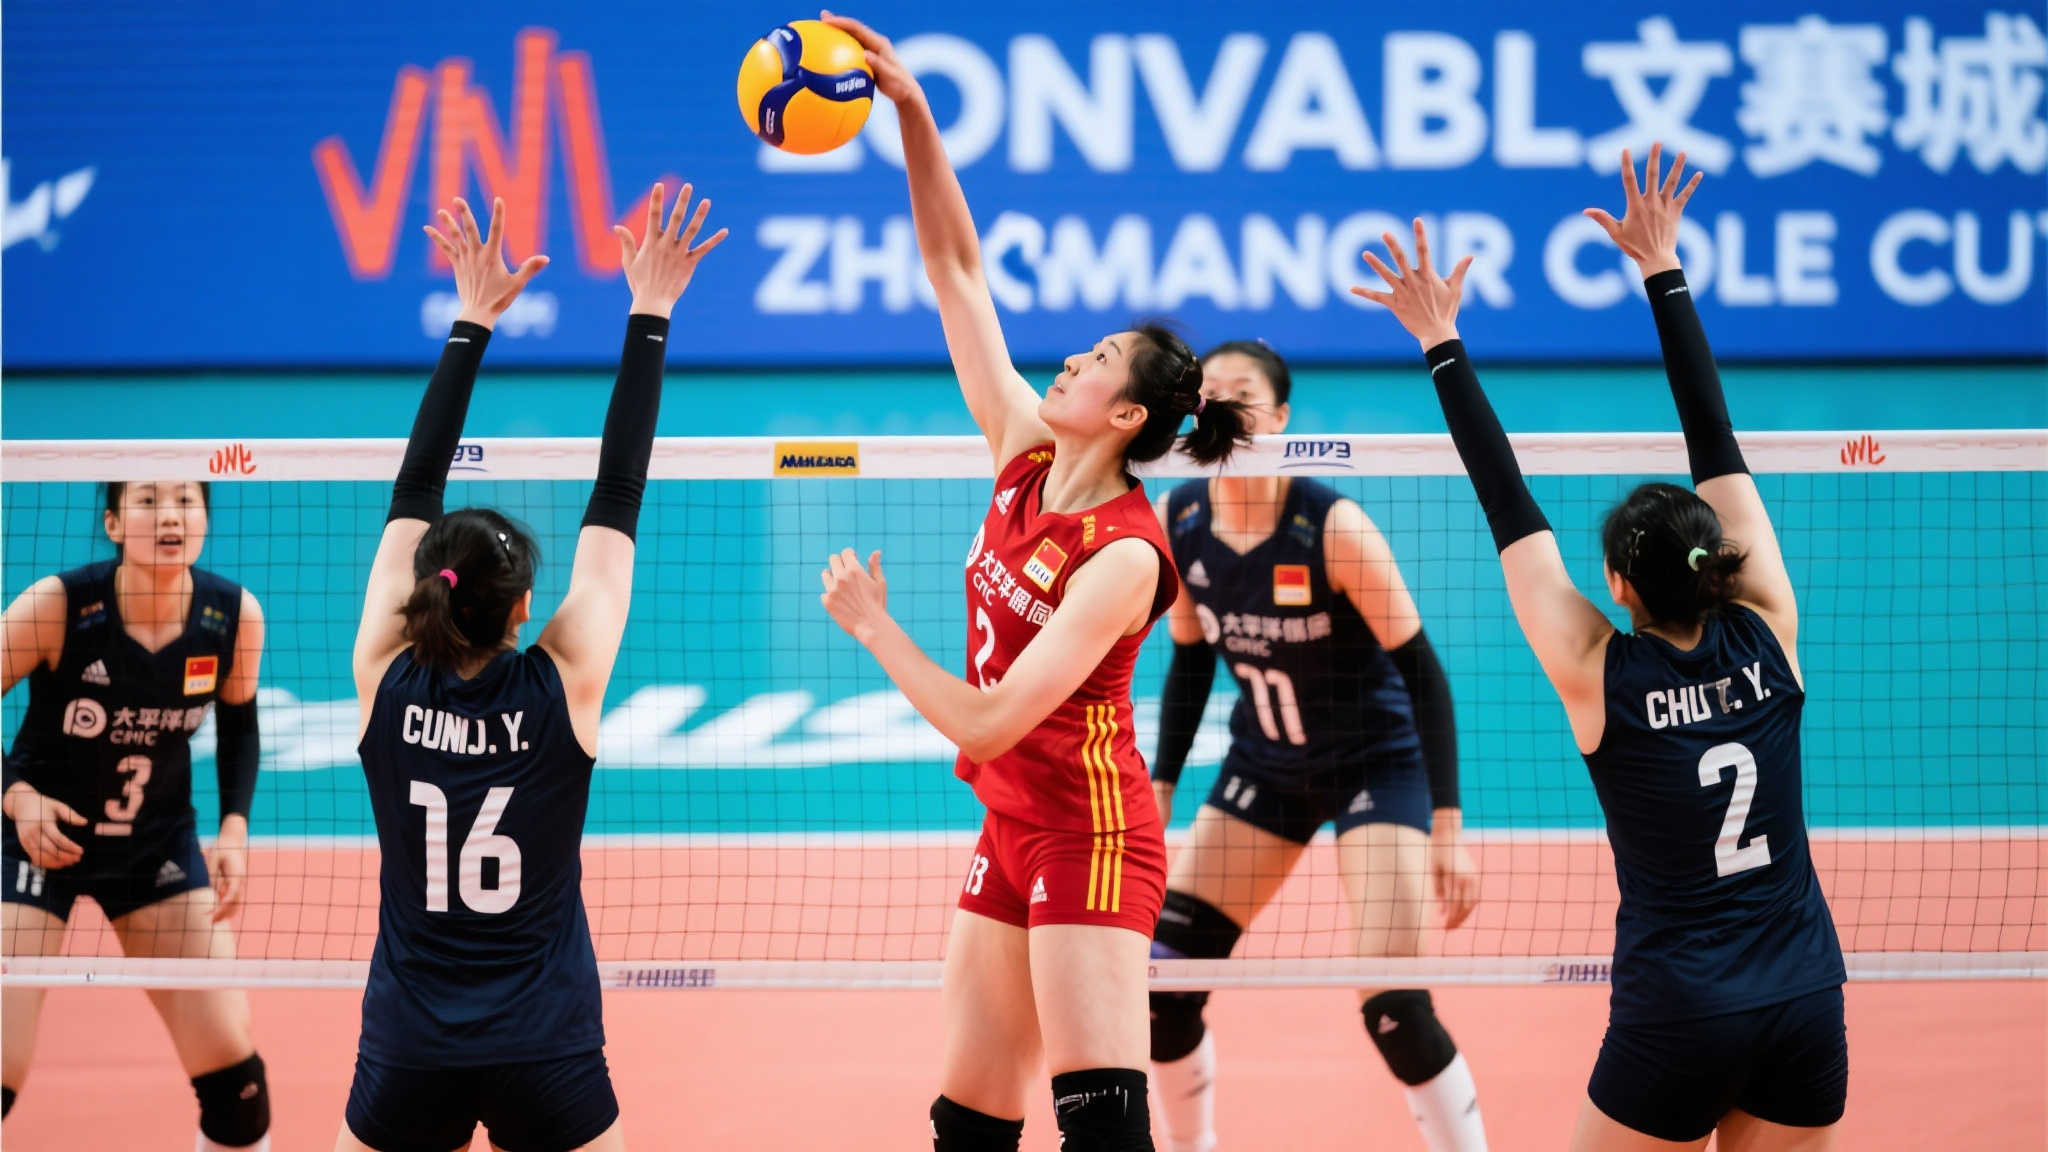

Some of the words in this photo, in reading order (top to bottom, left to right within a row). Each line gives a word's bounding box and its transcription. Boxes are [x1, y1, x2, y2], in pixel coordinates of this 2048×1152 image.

[757, 30, 1586, 174] ONVABL
[1868, 208, 2048, 306] CU
[409, 779, 522, 914] 16
[1697, 741, 1772, 878] 2
